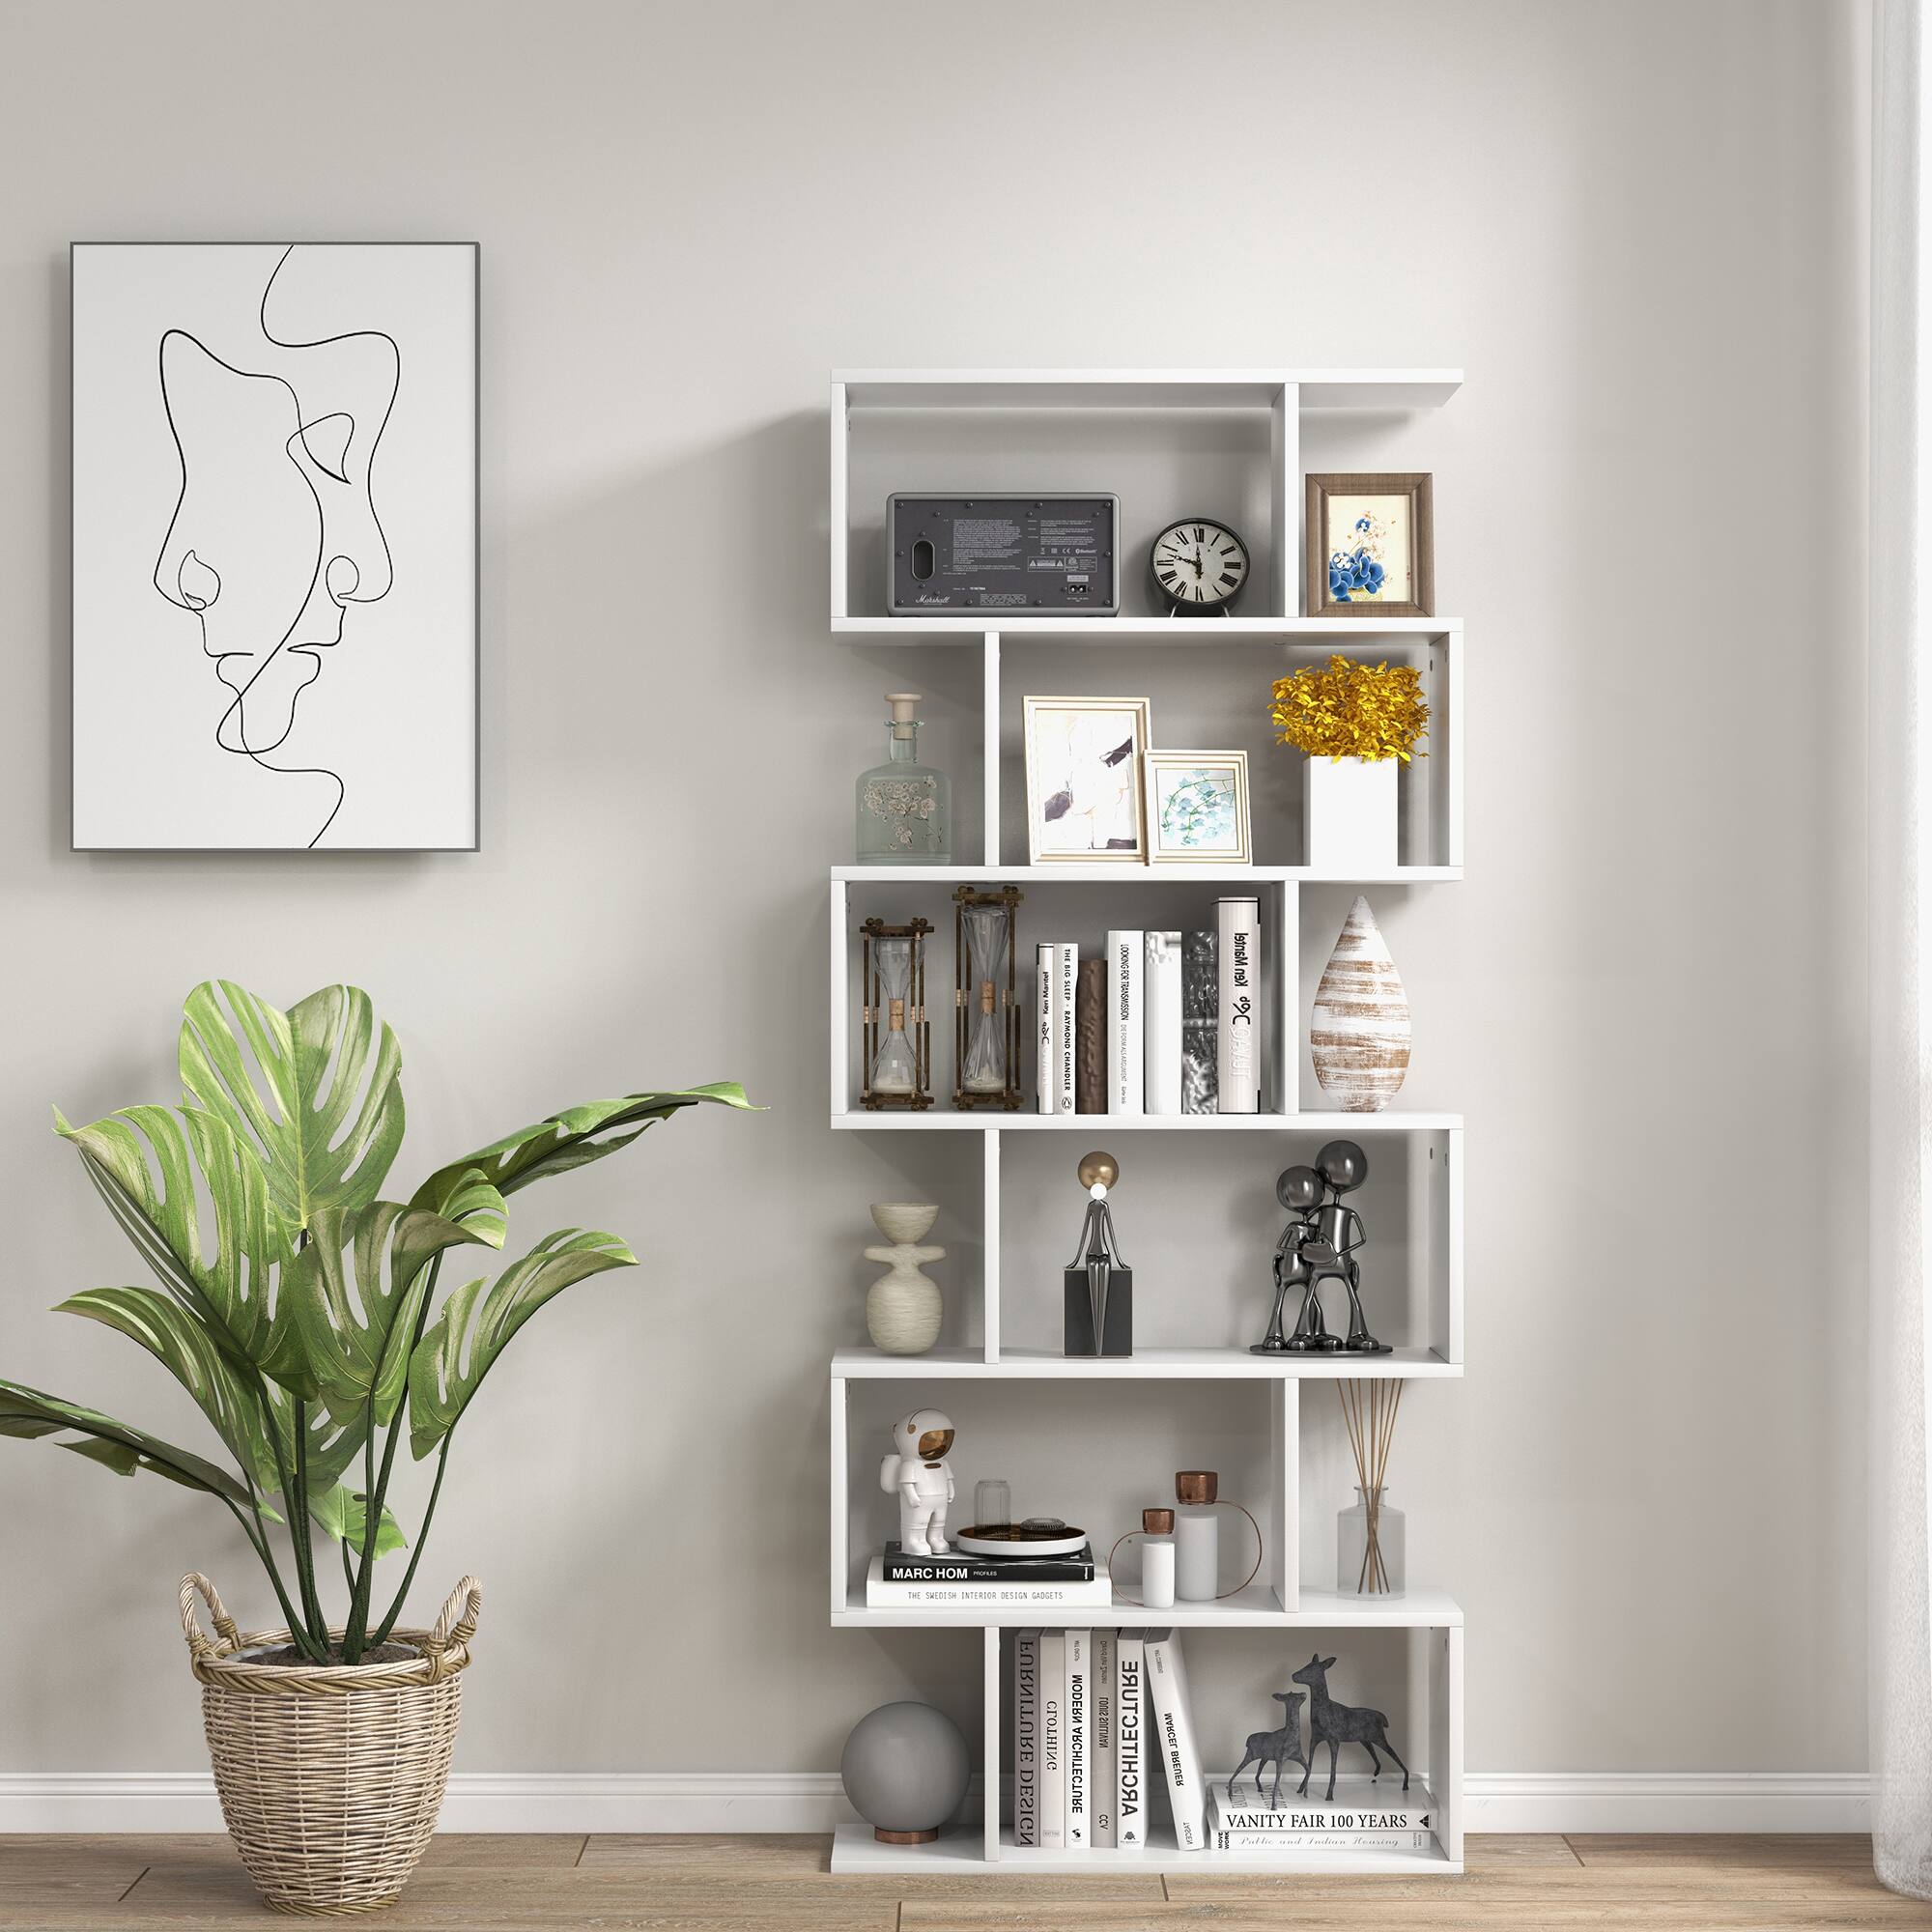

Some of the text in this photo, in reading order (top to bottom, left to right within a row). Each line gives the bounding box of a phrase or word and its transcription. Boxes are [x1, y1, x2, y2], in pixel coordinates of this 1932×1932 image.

[915, 594, 951, 604] Marshall
[1121, 944, 1129, 969] LOOKING
[1121, 970, 1129, 980] FOR
[1121, 981, 1129, 1021] TRANSMISSION
[892, 1567, 933, 1579] MARC
[936, 1567, 968, 1579] HOM
[908, 1591, 1064, 1600] THE SWEDISH INTERIOR DESIGN GADGETS
[1226, 1814, 1407, 1829] VANITY FAIR 100 YEARS
[1238, 1836, 1399, 1848] Public and Indian Housing
